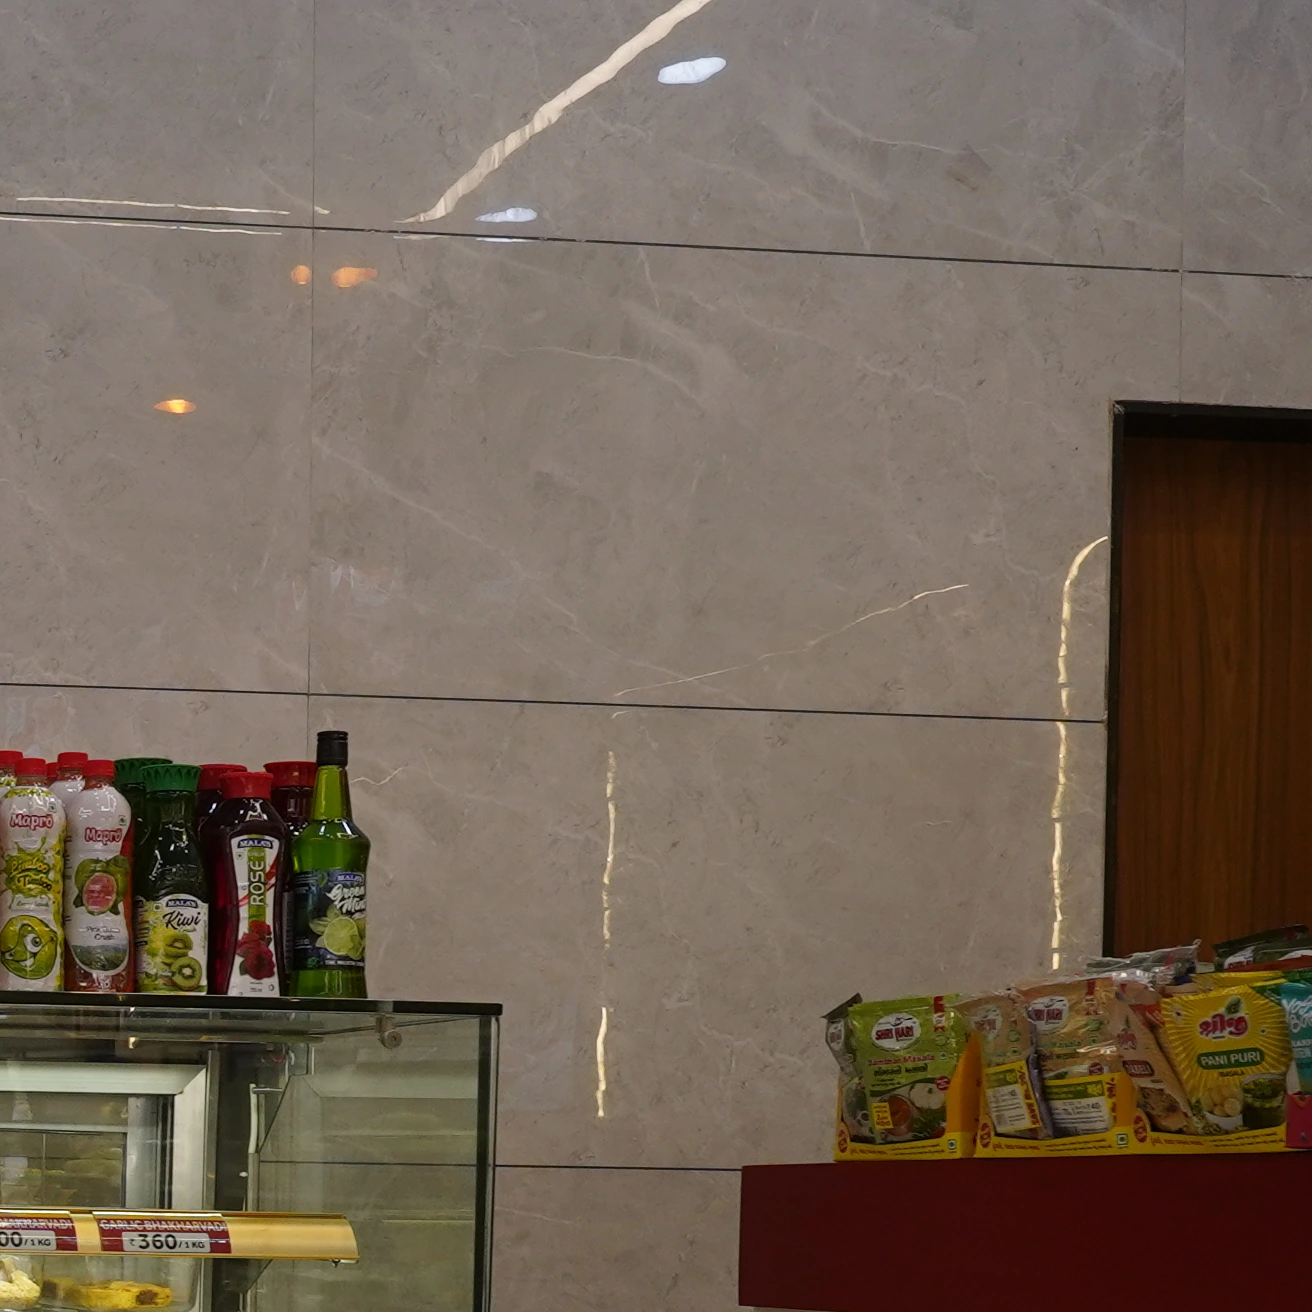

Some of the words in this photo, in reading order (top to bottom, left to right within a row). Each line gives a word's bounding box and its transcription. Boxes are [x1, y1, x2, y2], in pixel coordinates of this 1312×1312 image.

[162, 910, 202, 931] Kiwi
[1200, 1055, 1228, 1066] PANI
[1230, 1050, 1261, 1064] PURI
